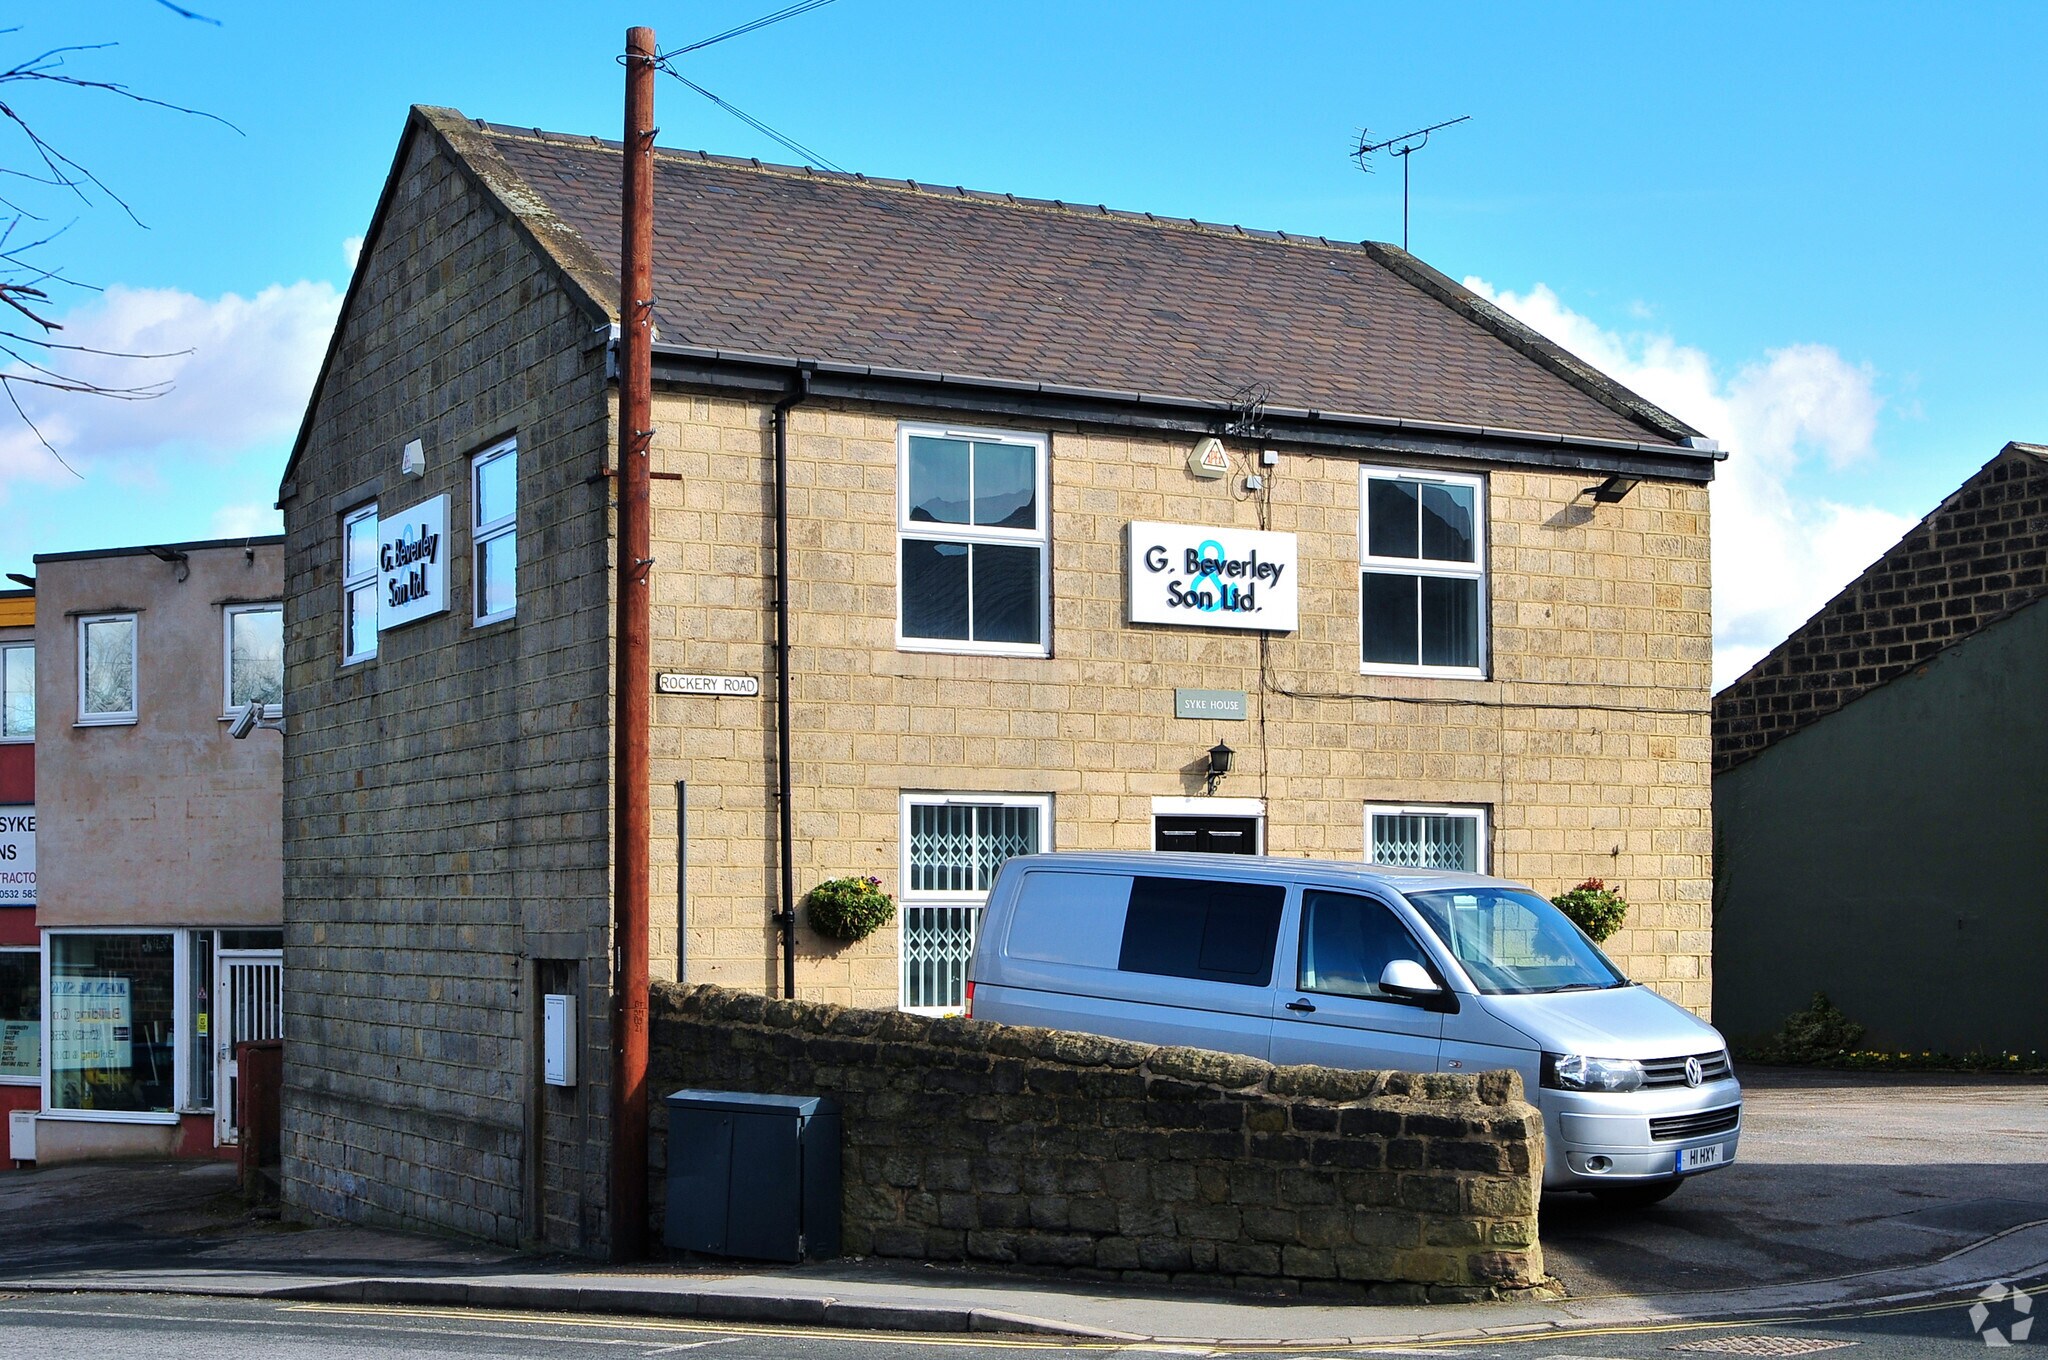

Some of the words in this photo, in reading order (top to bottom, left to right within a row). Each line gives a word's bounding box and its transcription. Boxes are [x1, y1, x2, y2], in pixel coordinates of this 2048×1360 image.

[380, 543, 395, 572] G.
[395, 523, 440, 568] Beverley
[1144, 544, 1176, 575] G.
[1183, 547, 1285, 590] Beverley
[388, 578, 410, 608] Son
[1166, 579, 1214, 610] Son
[1220, 581, 1262, 613] Ltd.
[661, 676, 718, 691] ROCKERY
[723, 678, 755, 693] ROAD
[1184, 699, 1207, 709] SYKE
[1210, 700, 1239, 710] HOUSE
[0, 816, 36, 833] SYKE
[1699, 1146, 1715, 1164] HXY
